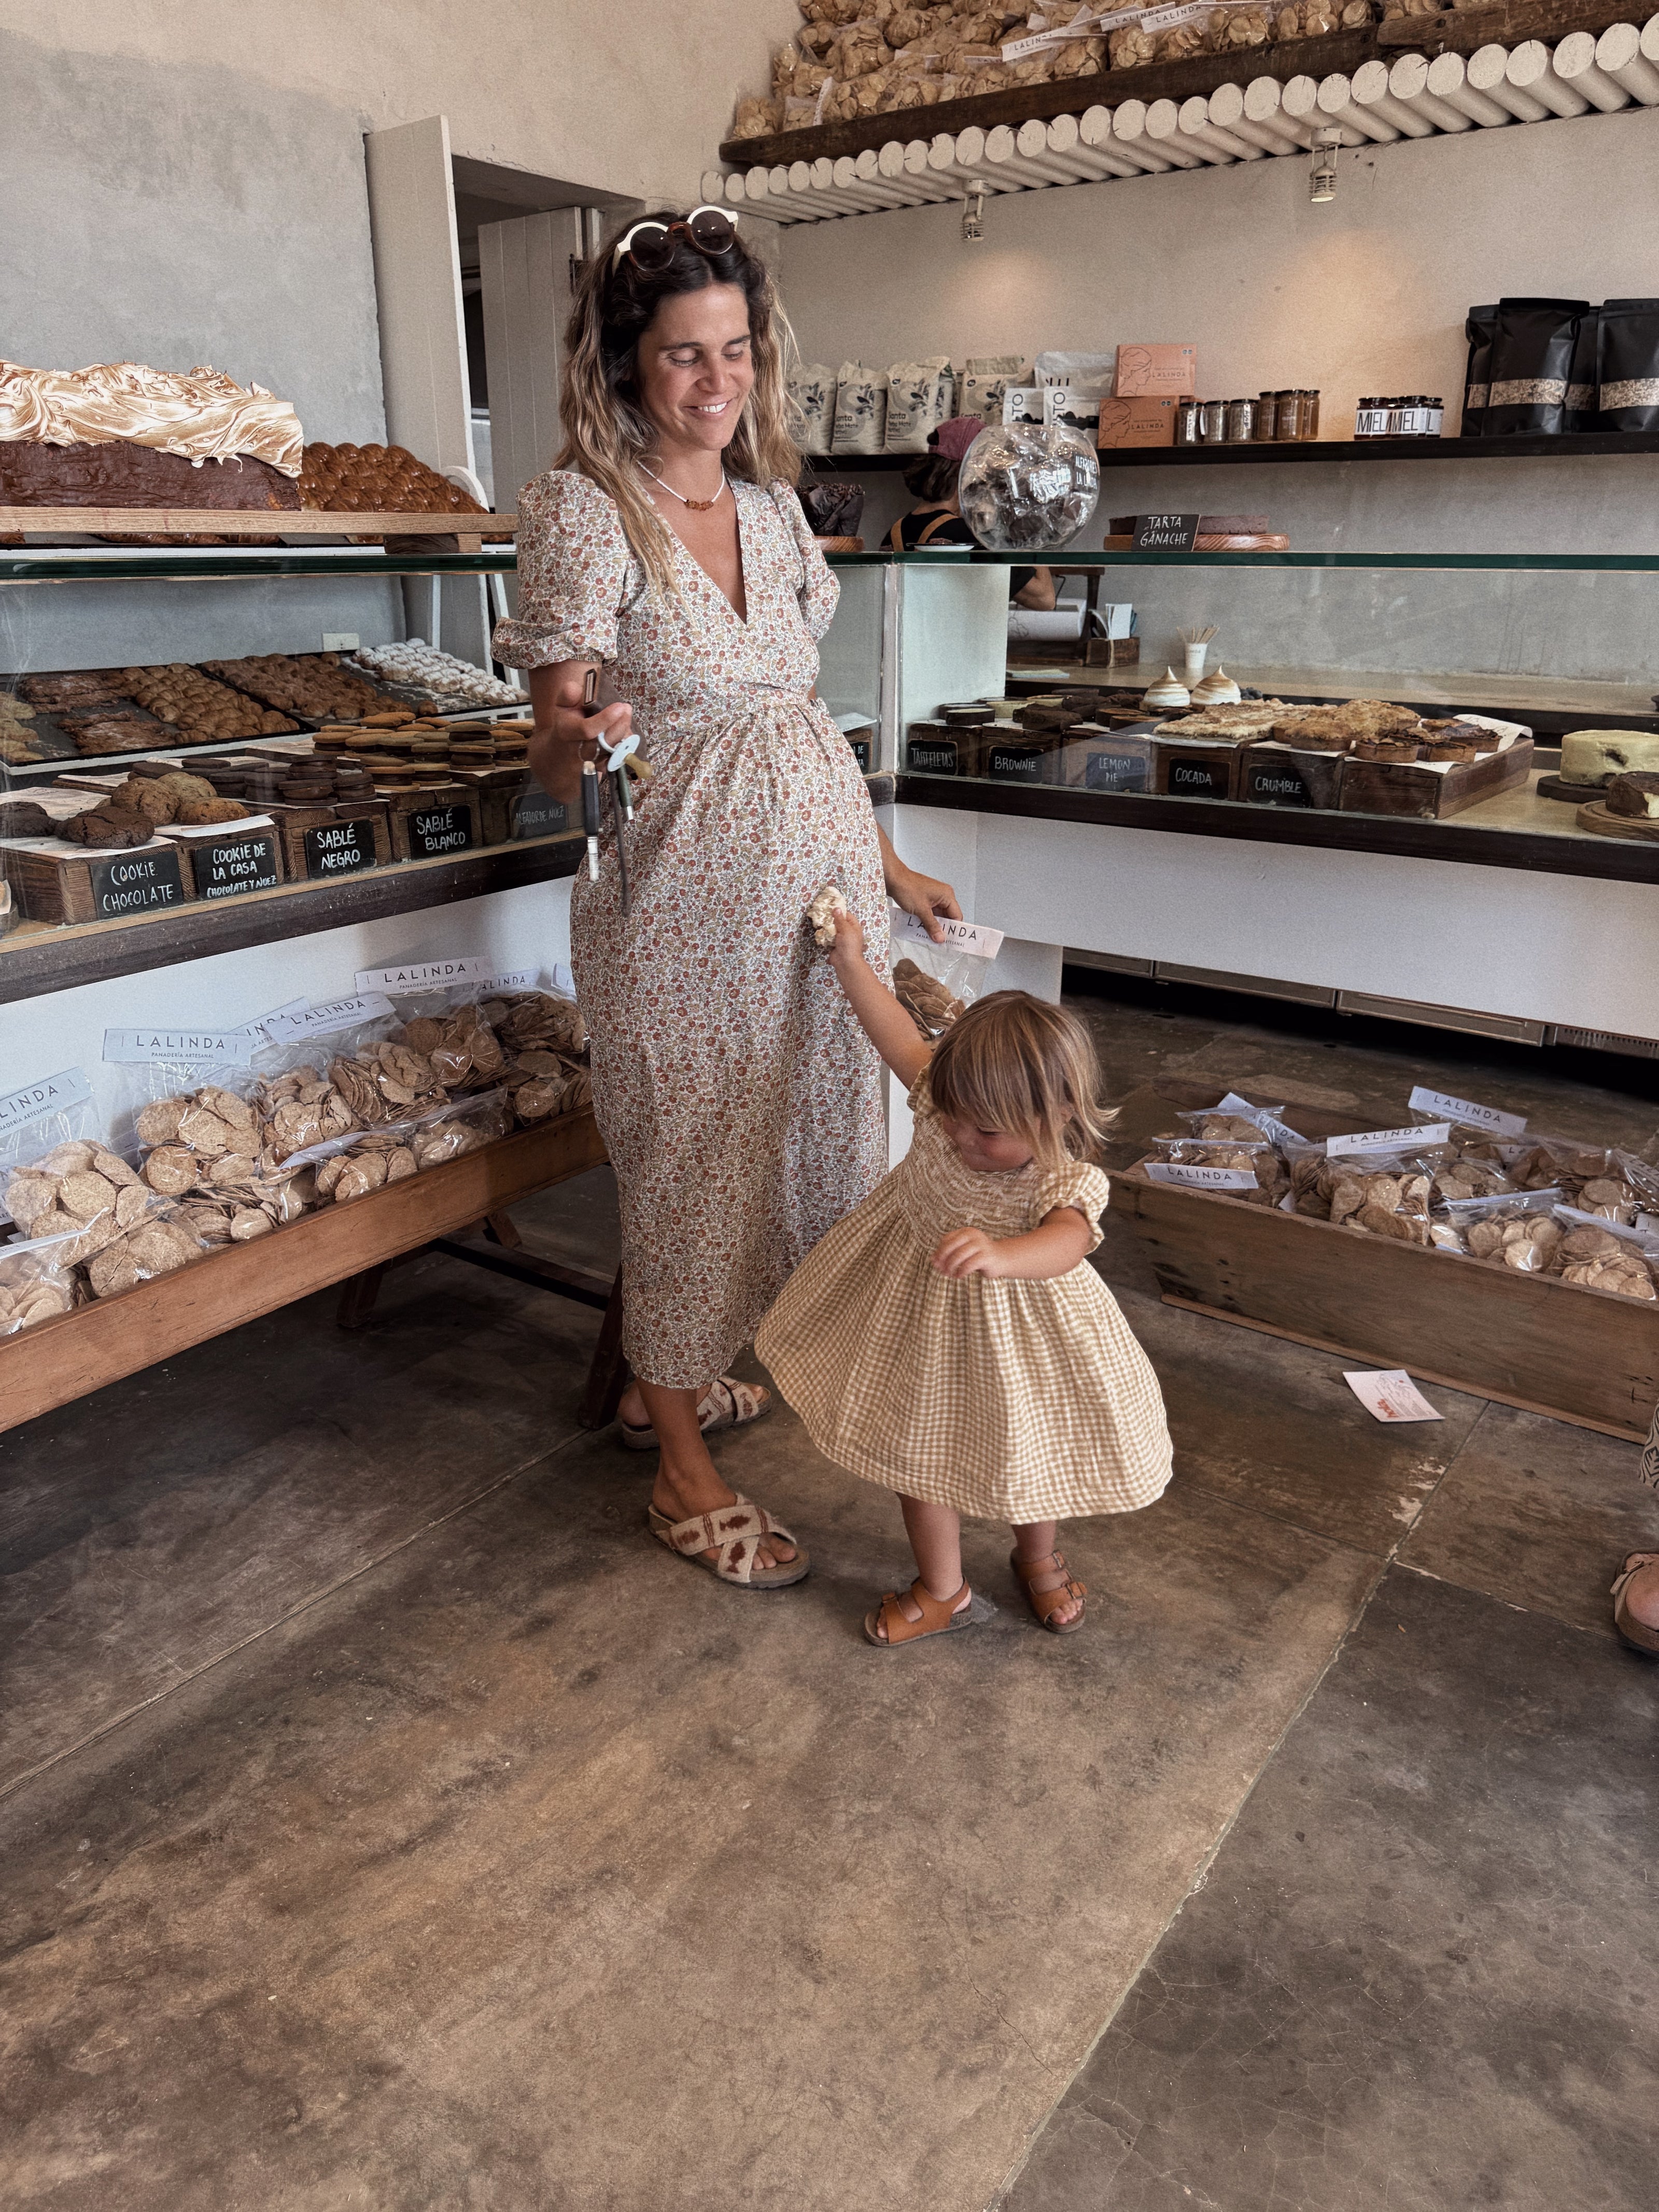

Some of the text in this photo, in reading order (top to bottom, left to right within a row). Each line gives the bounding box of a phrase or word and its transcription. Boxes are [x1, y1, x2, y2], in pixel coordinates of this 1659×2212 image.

[1014, 34, 1052, 51] LALIN
[1357, 411, 1386, 433] MIEL
[1147, 515, 1182, 530] TARTA
[1099, 756, 1131, 770] LEMON
[1175, 767, 1213, 786] COCADA
[1255, 776, 1302, 794] CRUMBLE
[416, 807, 454, 836] SABLÉ
[316, 822, 357, 850] SABLÉ
[425, 831, 466, 851] BLANCO
[253, 842, 266, 858] DE
[320, 849, 361, 870] NEGRO
[212, 860, 258, 881] LA CASA
[206, 875, 277, 898] CHOCOLATE Y NUEZ
[103, 884, 174, 912] CHOCOLATE
[907, 915, 977, 940] LAINDA
[384, 963, 467, 983] LALINDA
[429, 977, 458, 986] ARTESANAL
[290, 999, 366, 1025] LALINDA
[136, 1035, 225, 1049] LALINDA
[24, 1103, 54, 1121] ARTESANAL
[1433, 1094, 1502, 1123] LALINDA
[1350, 1127, 1424, 1144] LALINDA
[1166, 1167, 1232, 1180] LALINDA
